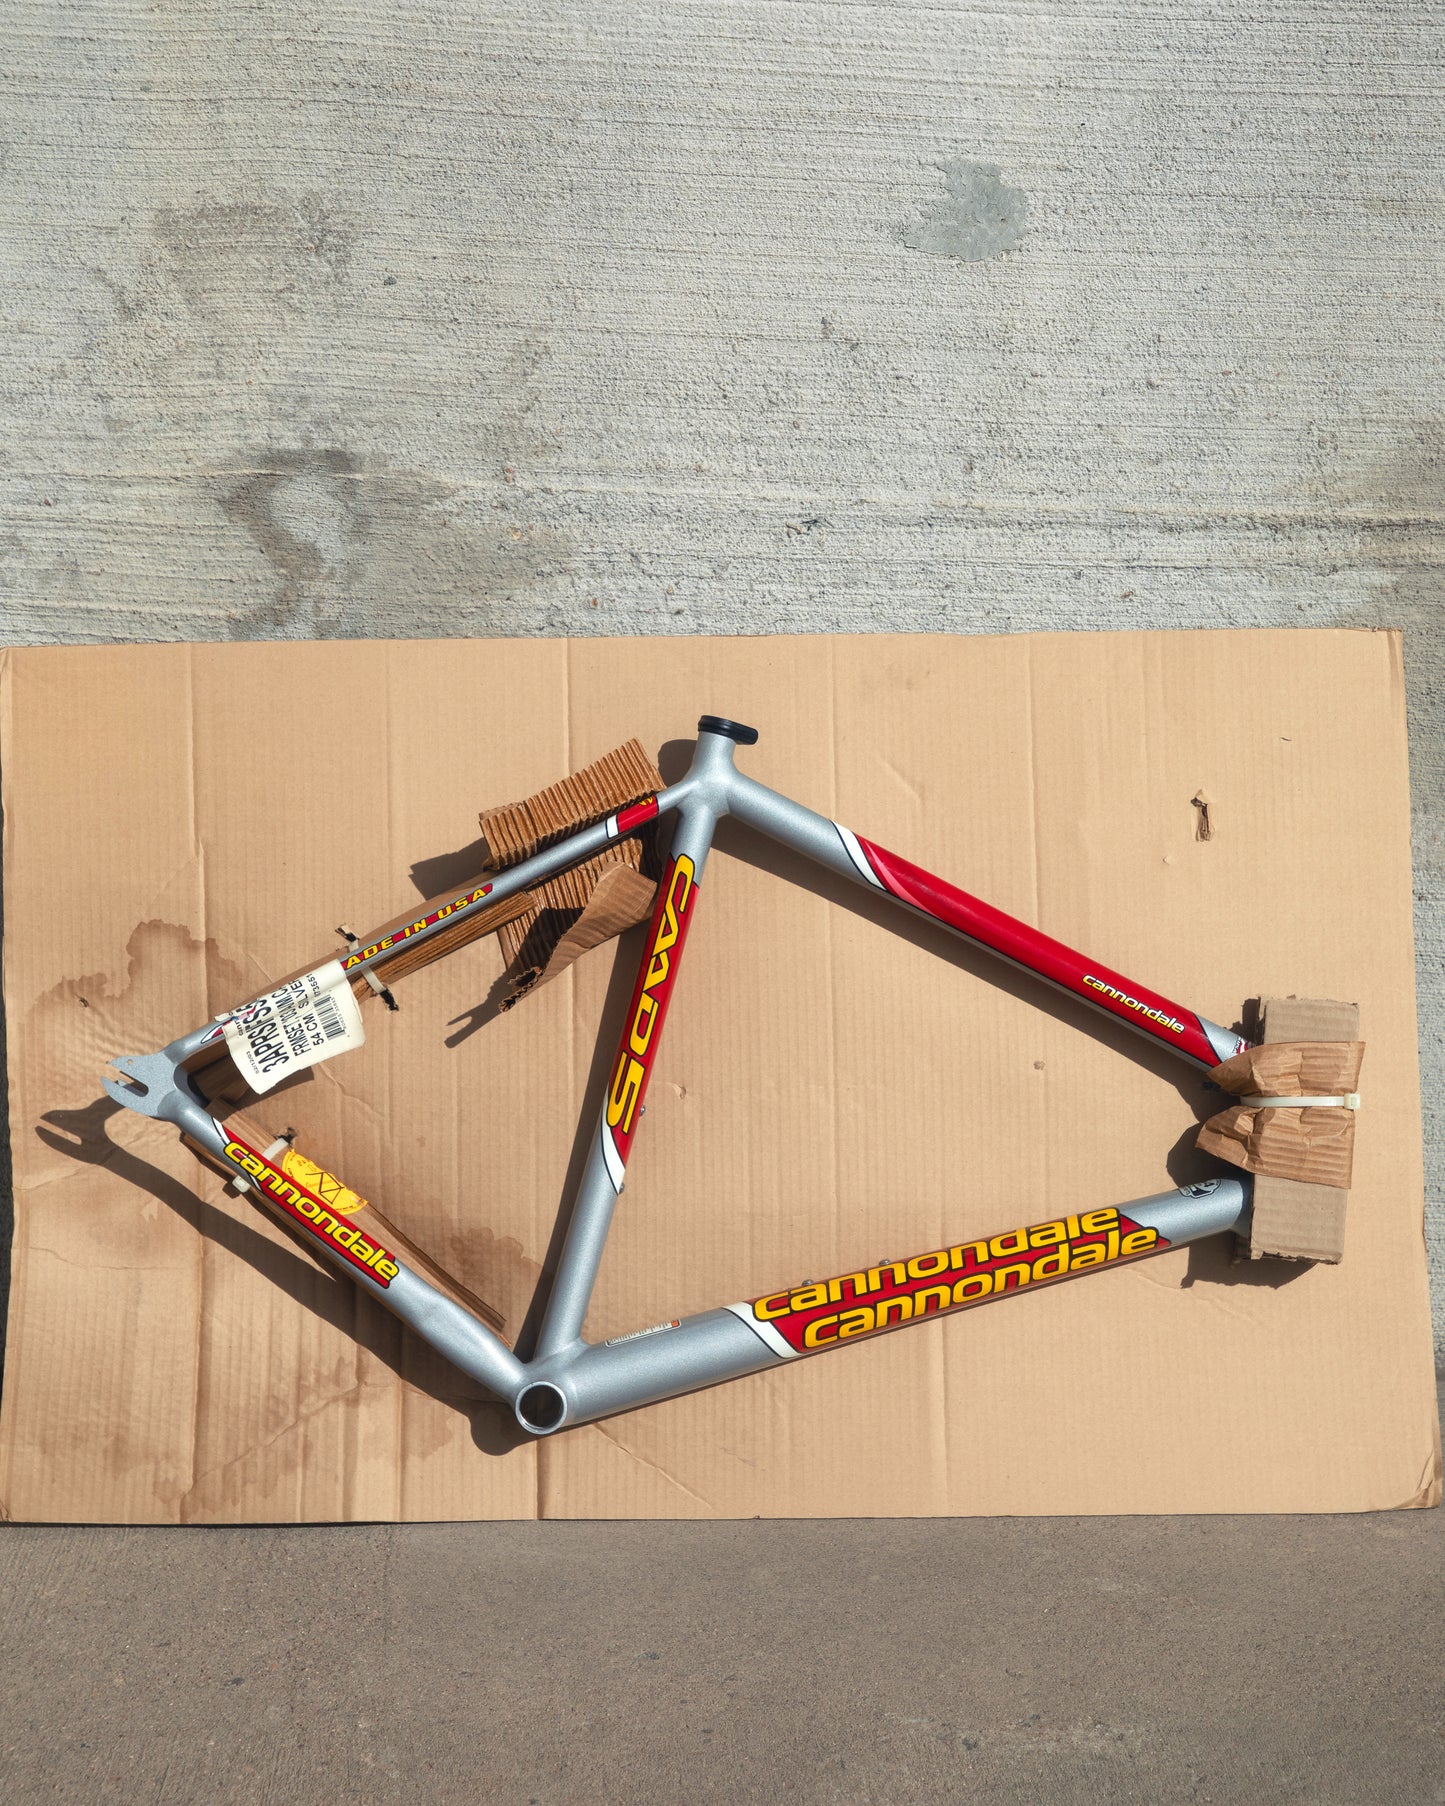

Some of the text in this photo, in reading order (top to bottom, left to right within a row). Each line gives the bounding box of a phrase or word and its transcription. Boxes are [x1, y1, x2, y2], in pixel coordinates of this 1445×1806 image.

[345, 888, 487, 969] ADE IN USA
[302, 1013, 318, 1032] CM
[312, 1031, 325, 1046] 54
[1083, 974, 1185, 1034] cannondale
[224, 1142, 399, 1281] cannondale
[753, 1206, 1120, 1321] cannondale
[804, 1227, 1158, 1349] cannondale
